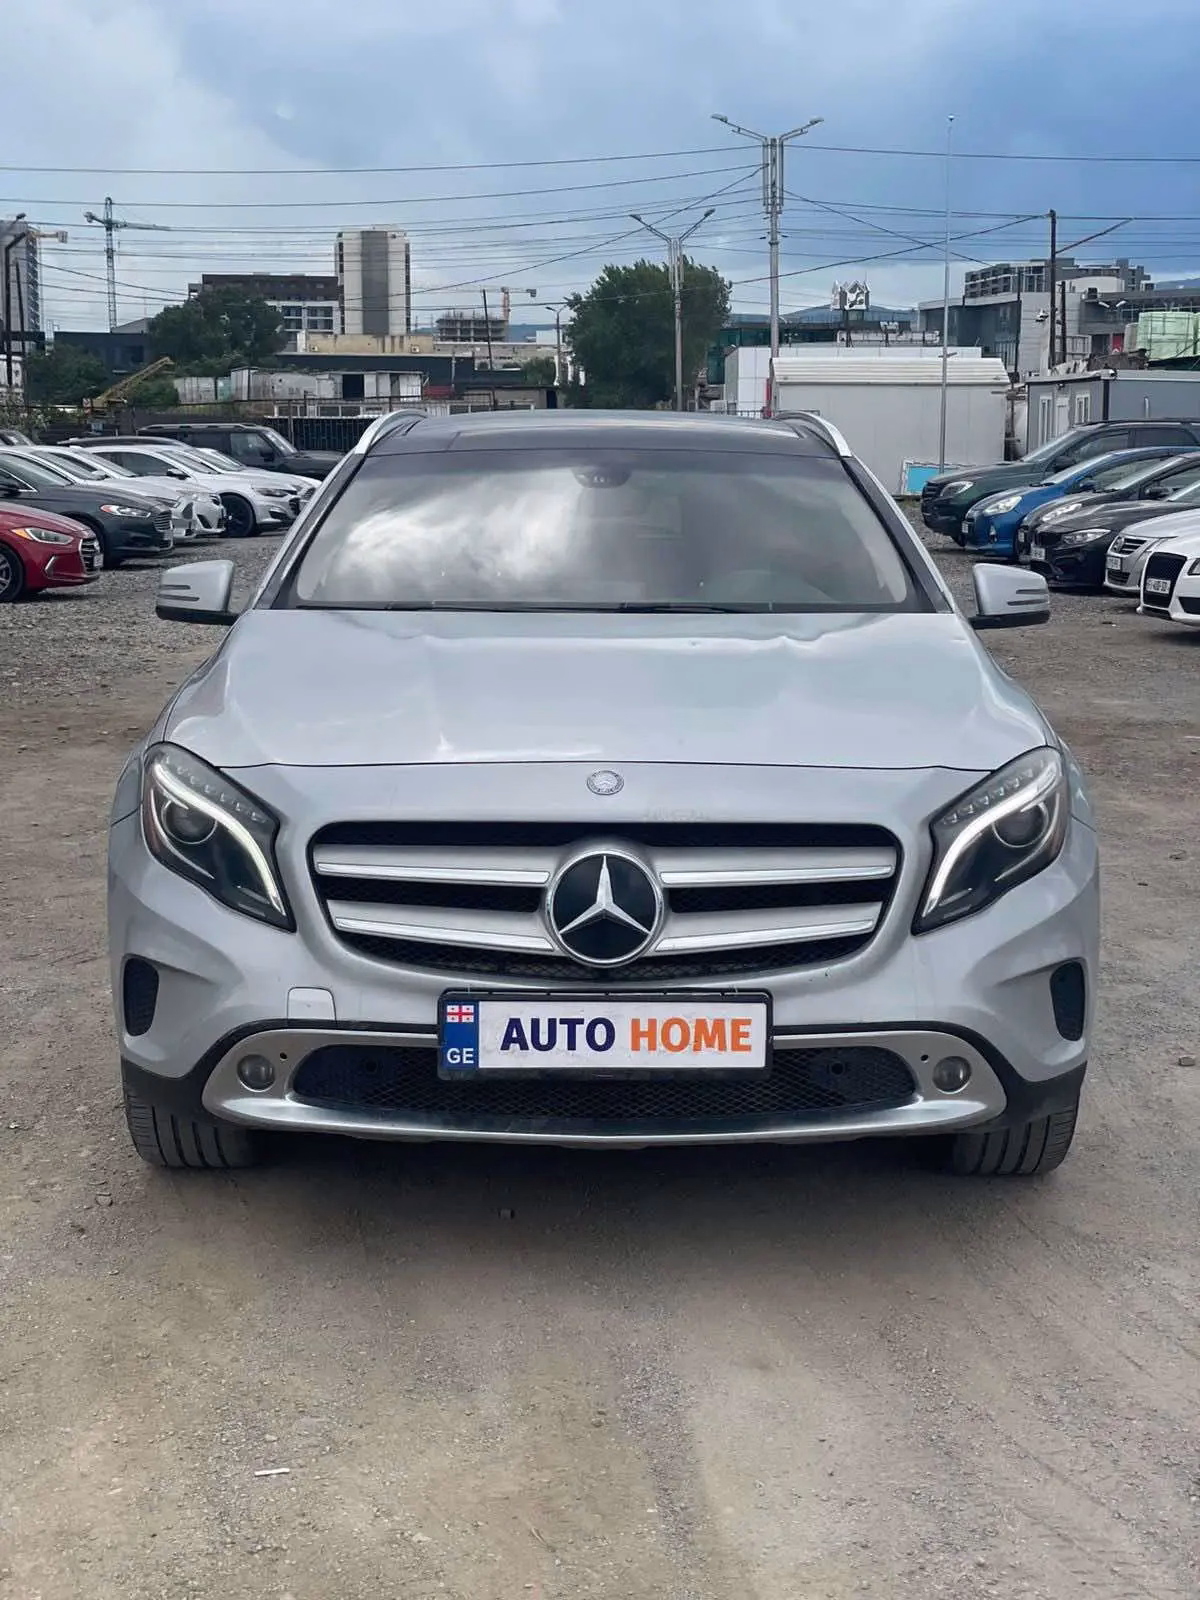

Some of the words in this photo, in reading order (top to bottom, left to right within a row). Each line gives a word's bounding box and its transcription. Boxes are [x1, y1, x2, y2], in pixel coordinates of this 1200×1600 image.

[501, 1018, 615, 1051] AUTO
[630, 1018, 752, 1052] HOME
[446, 1048, 474, 1064] GE
